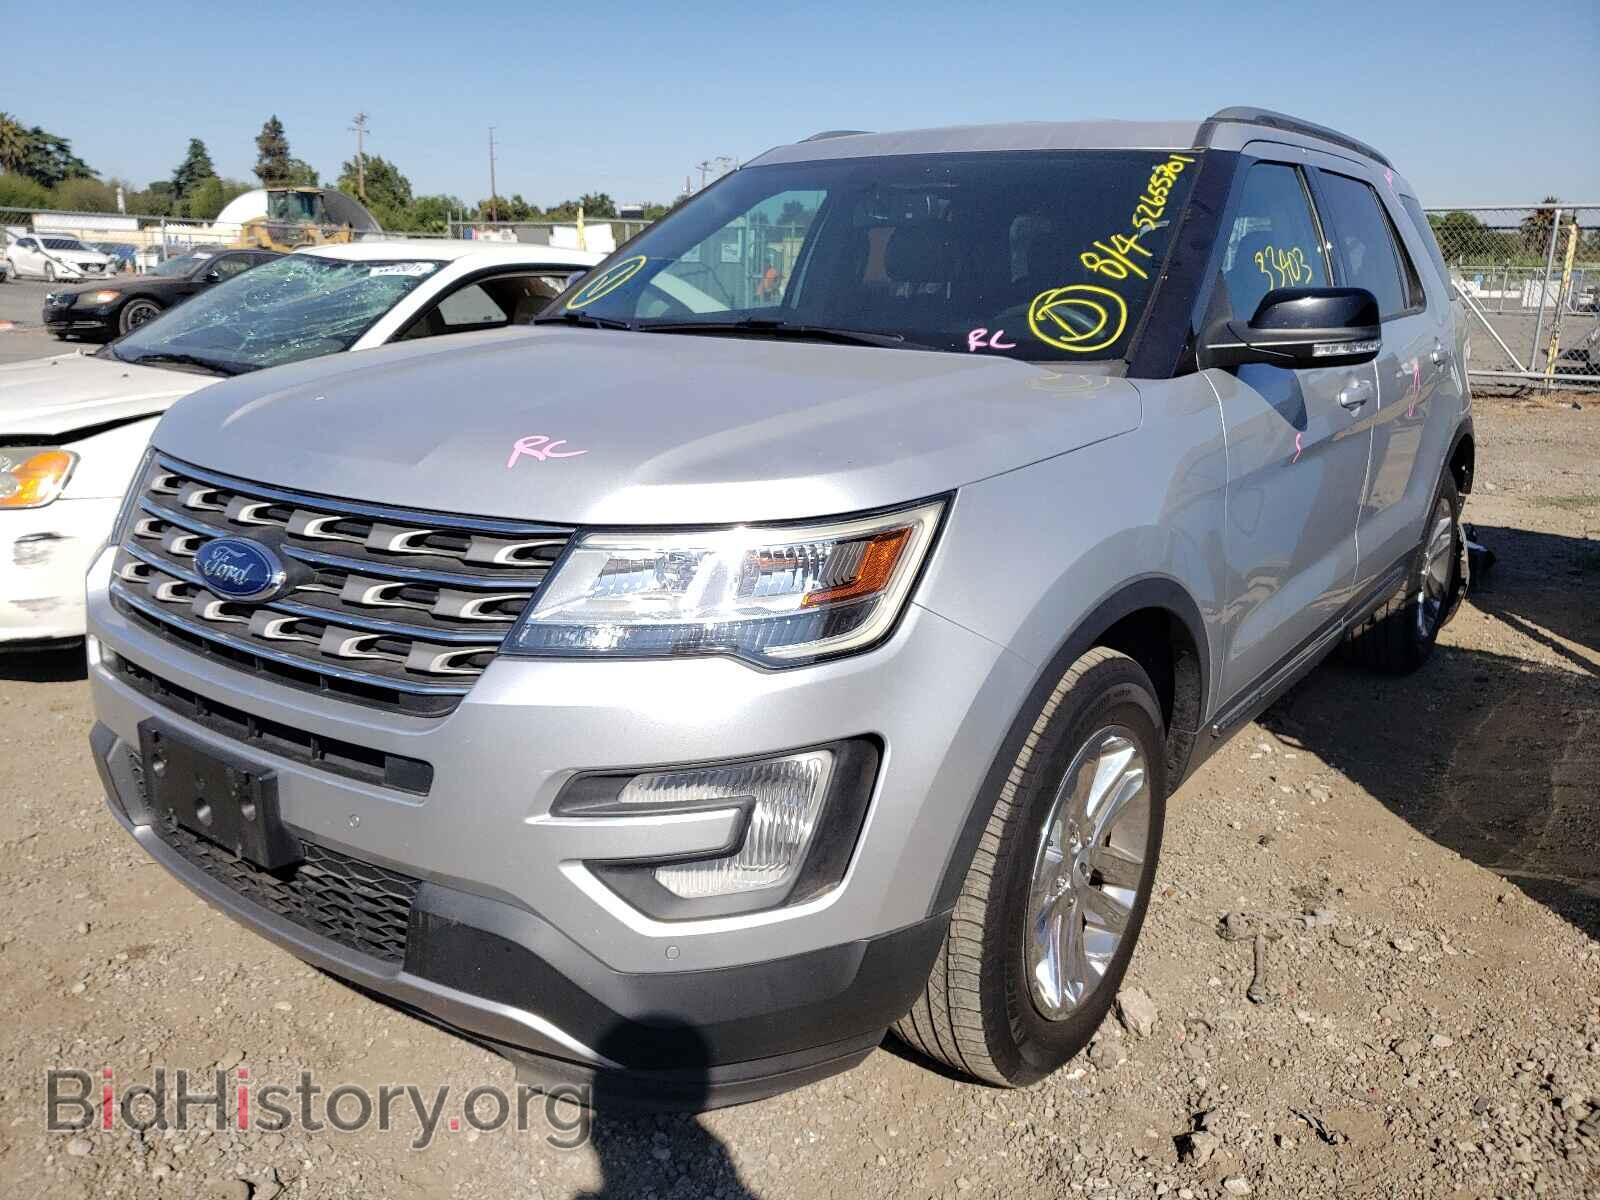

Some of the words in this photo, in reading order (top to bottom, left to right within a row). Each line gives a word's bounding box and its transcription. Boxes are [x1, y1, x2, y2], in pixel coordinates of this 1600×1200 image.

[968, 328, 1016, 352] RC
[507, 435, 588, 469] RC
[203, 545, 257, 586] Ford
